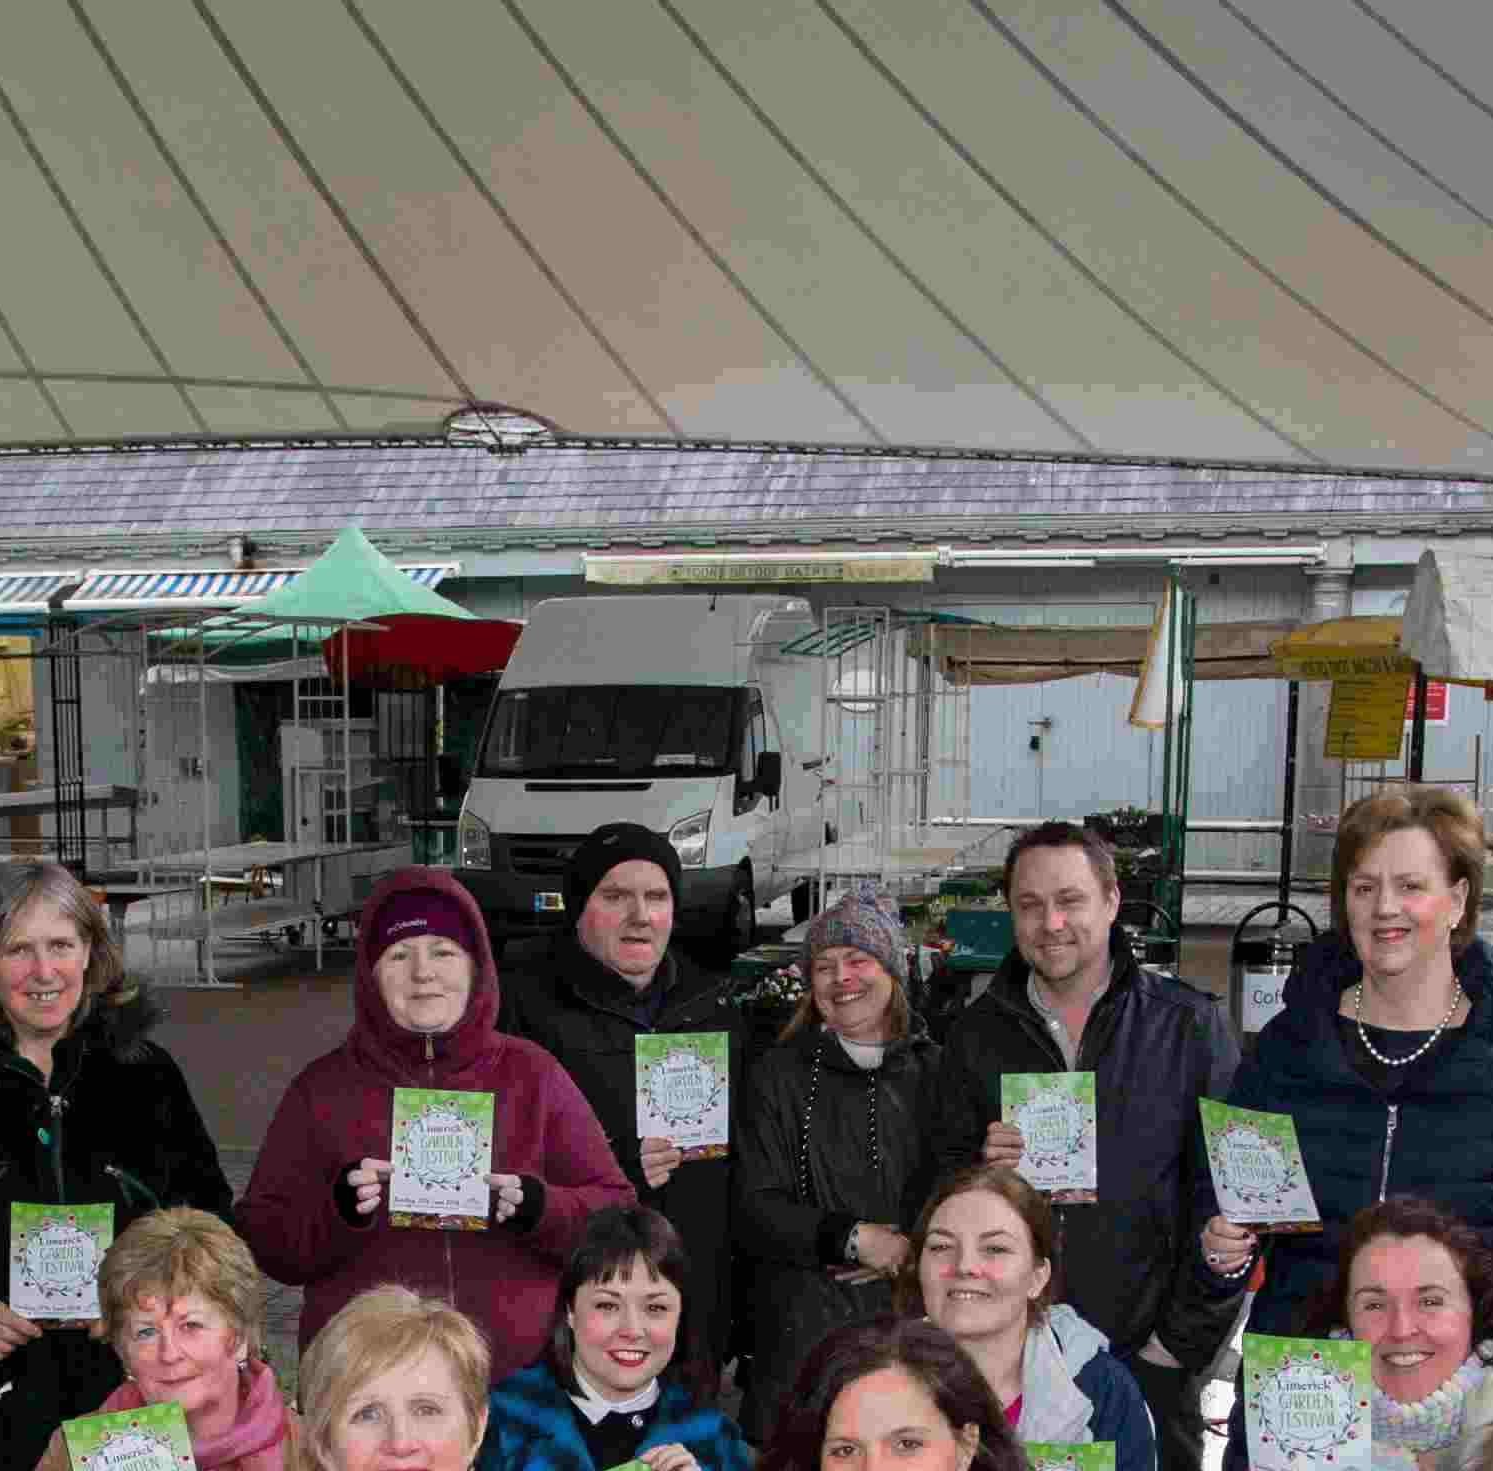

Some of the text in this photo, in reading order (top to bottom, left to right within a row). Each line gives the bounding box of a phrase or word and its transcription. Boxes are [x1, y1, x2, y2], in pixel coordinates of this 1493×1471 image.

[419, 1135, 464, 1150] GARDEN
[1277, 1377, 1332, 1392] Limerick
[1279, 1392, 1334, 1410] GARDEN
[1280, 1410, 1337, 1429] FESTIVAL
[104, 1444, 154, 1465] Limerick
